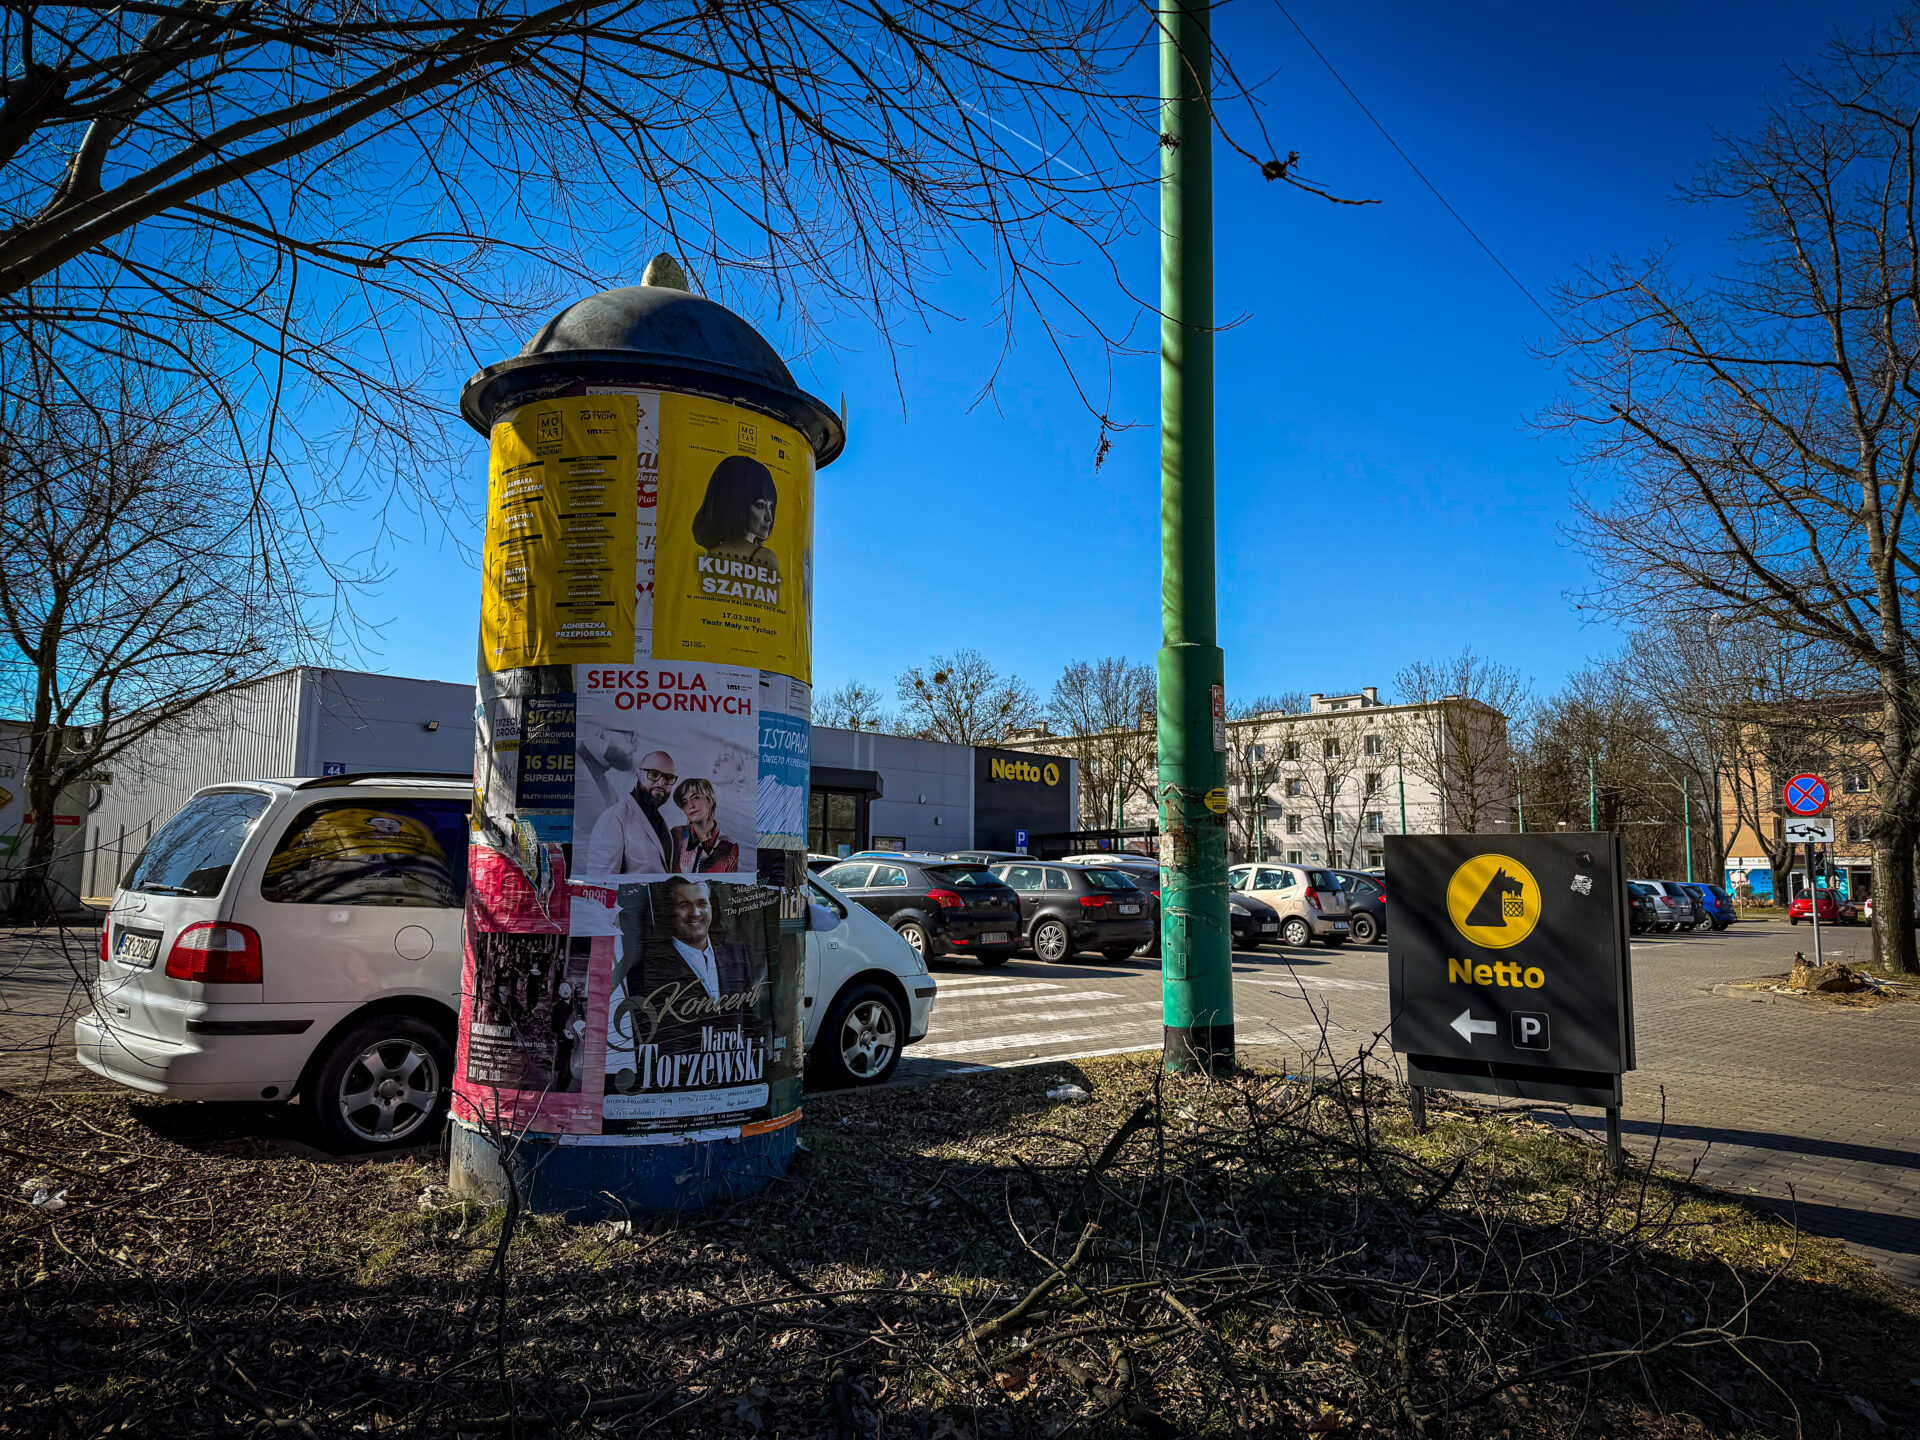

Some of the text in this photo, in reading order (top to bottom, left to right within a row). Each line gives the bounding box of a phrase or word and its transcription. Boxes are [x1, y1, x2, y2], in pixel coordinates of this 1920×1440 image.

[698, 556, 783, 585] KURDEJ-
[702, 577, 778, 605] SZATAN
[562, 622, 606, 630] AGNIESZKA
[701, 618, 723, 627] Teatr
[587, 670, 707, 691] SEKS DLA
[615, 691, 752, 716] OPORNYCH
[327, 766, 341, 776] 44
[524, 754, 574, 770] 16 SIE
[991, 758, 1041, 783] Netto
[1018, 831, 1026, 844] P
[1448, 958, 1545, 989] Netto
[643, 977, 774, 1024] Koncert
[700, 1023, 745, 1053] Marek
[1520, 1017, 1541, 1044] P
[638, 1036, 765, 1090] Torzewski
